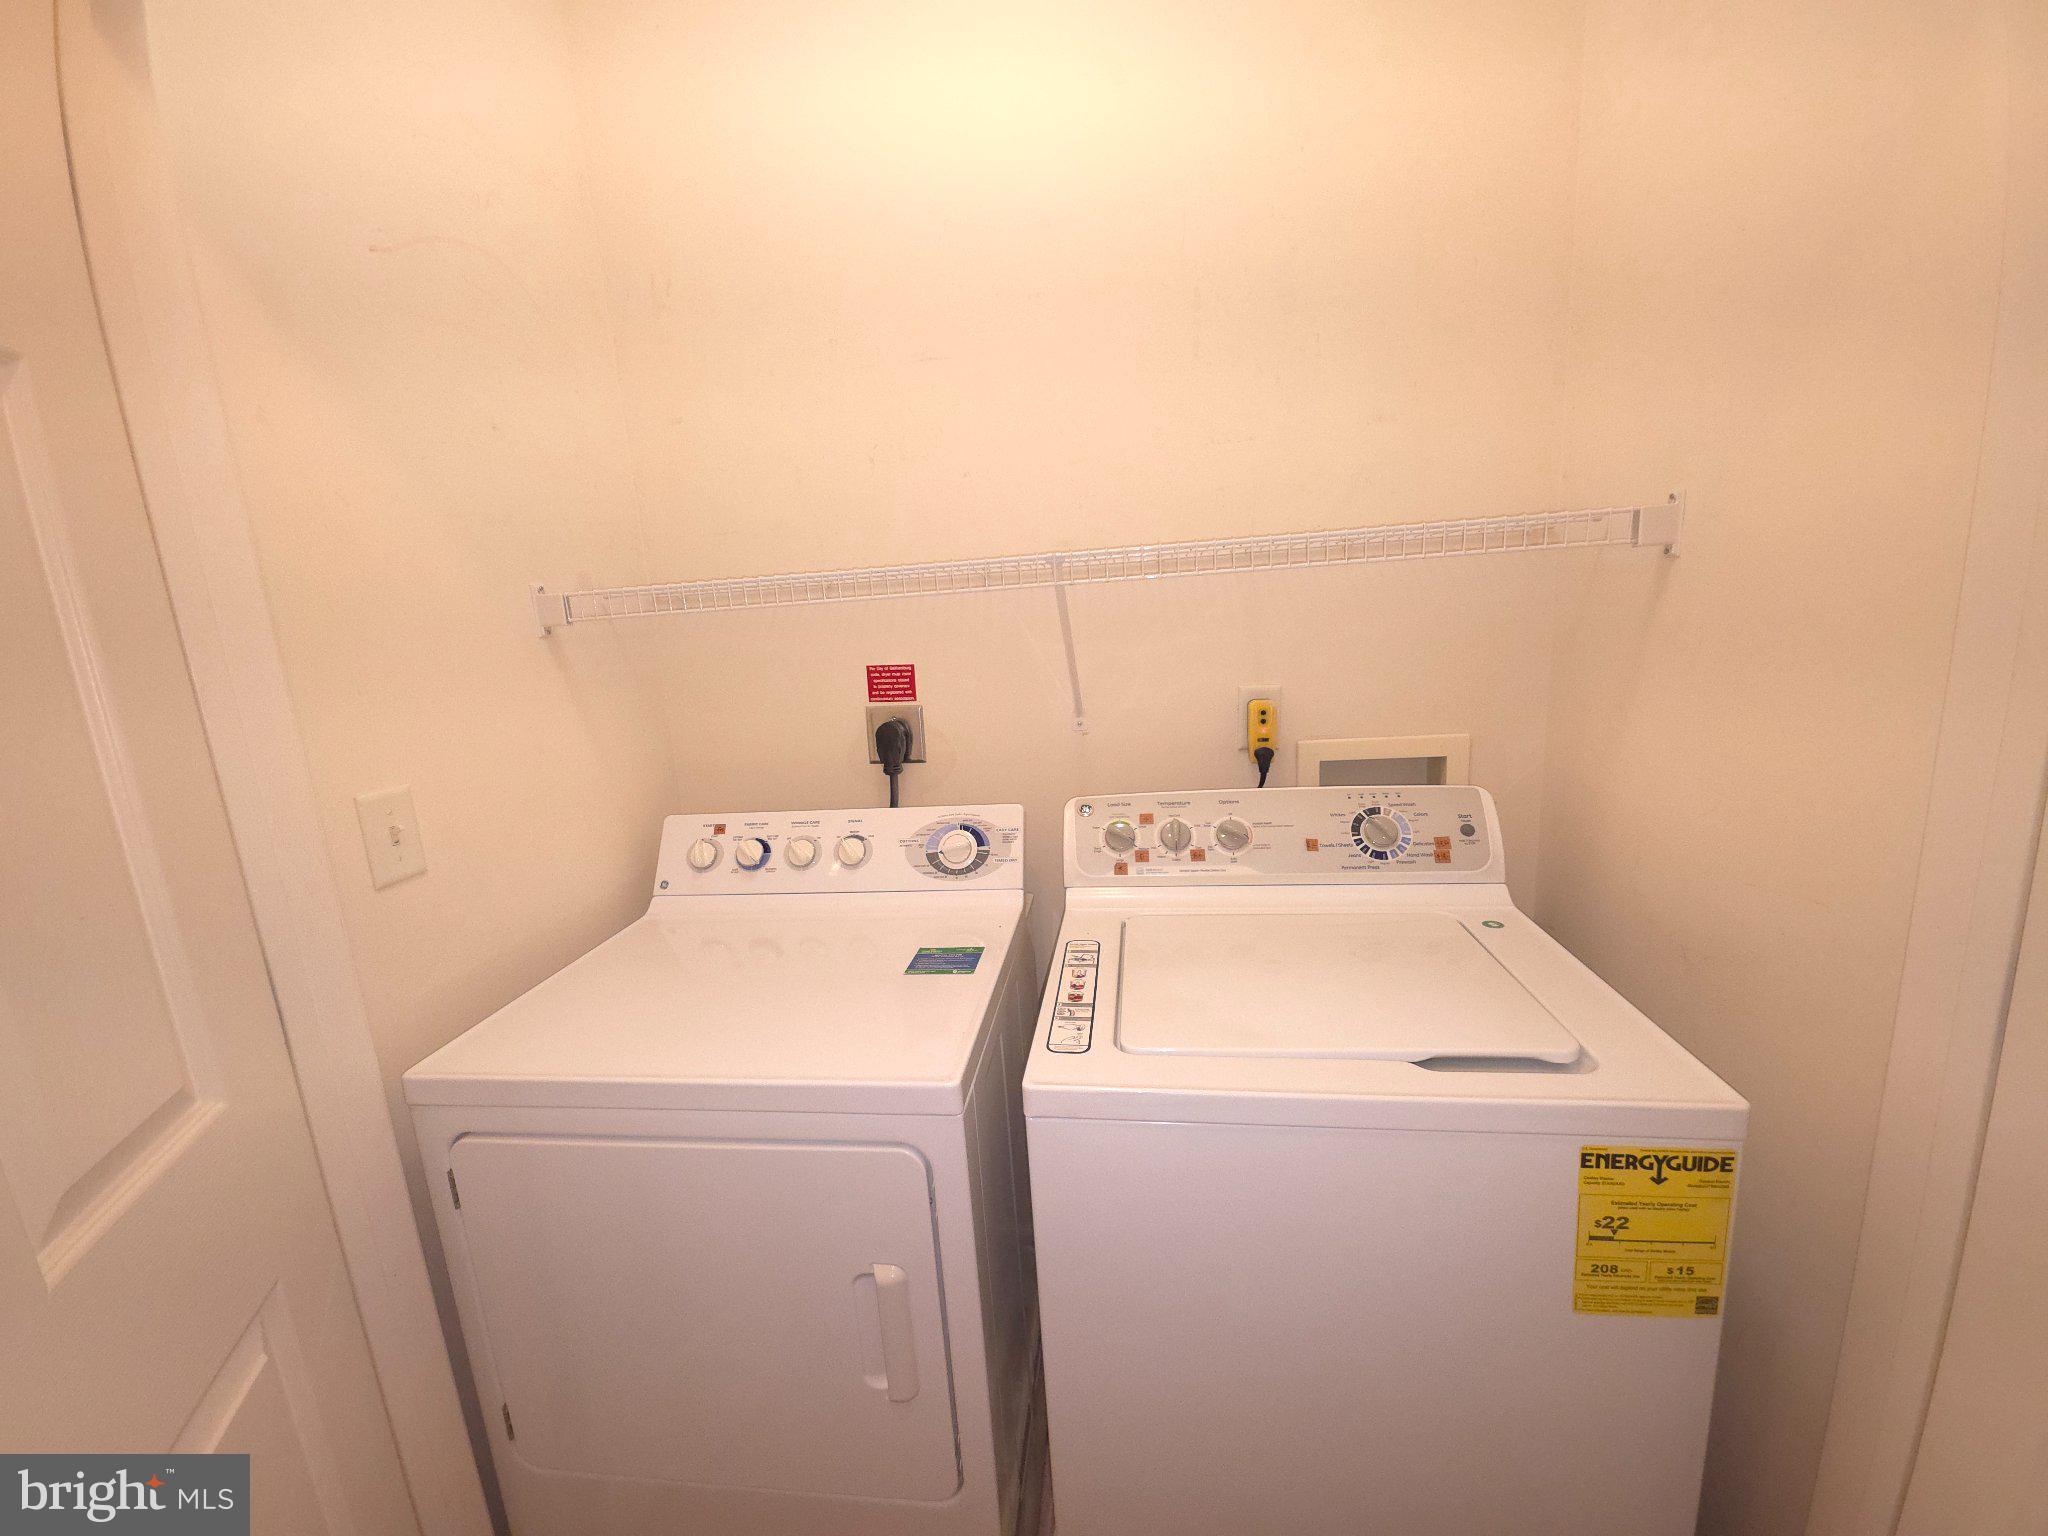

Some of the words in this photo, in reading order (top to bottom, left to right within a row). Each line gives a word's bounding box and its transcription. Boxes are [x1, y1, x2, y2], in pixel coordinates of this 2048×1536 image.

[1580, 1152, 1734, 1173] ENERGYGUIDE
[1594, 1216, 1630, 1230] $22
[1590, 1264, 1618, 1273] 208
